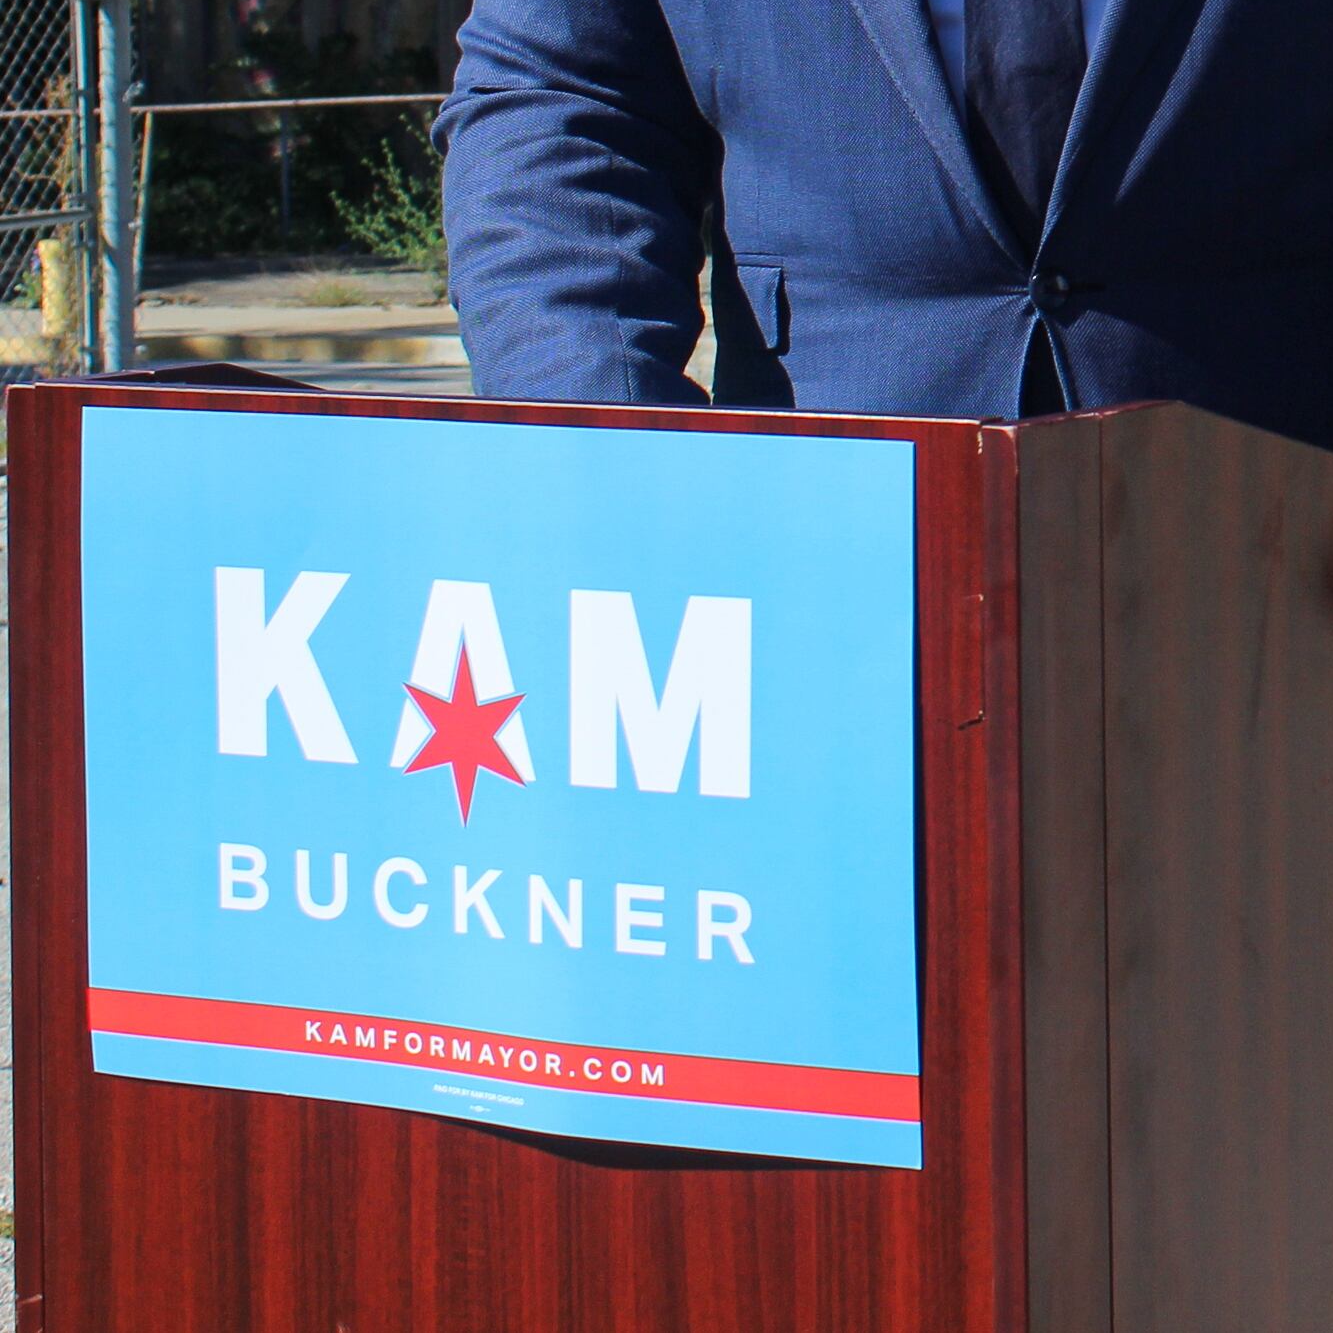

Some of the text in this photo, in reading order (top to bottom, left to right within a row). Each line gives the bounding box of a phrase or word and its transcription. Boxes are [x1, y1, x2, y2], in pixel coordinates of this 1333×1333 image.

[215, 565, 753, 800] KAM
[218, 841, 756, 964] BUCKNER
[304, 1020, 665, 1086] KAMFORMAYOR.COM
